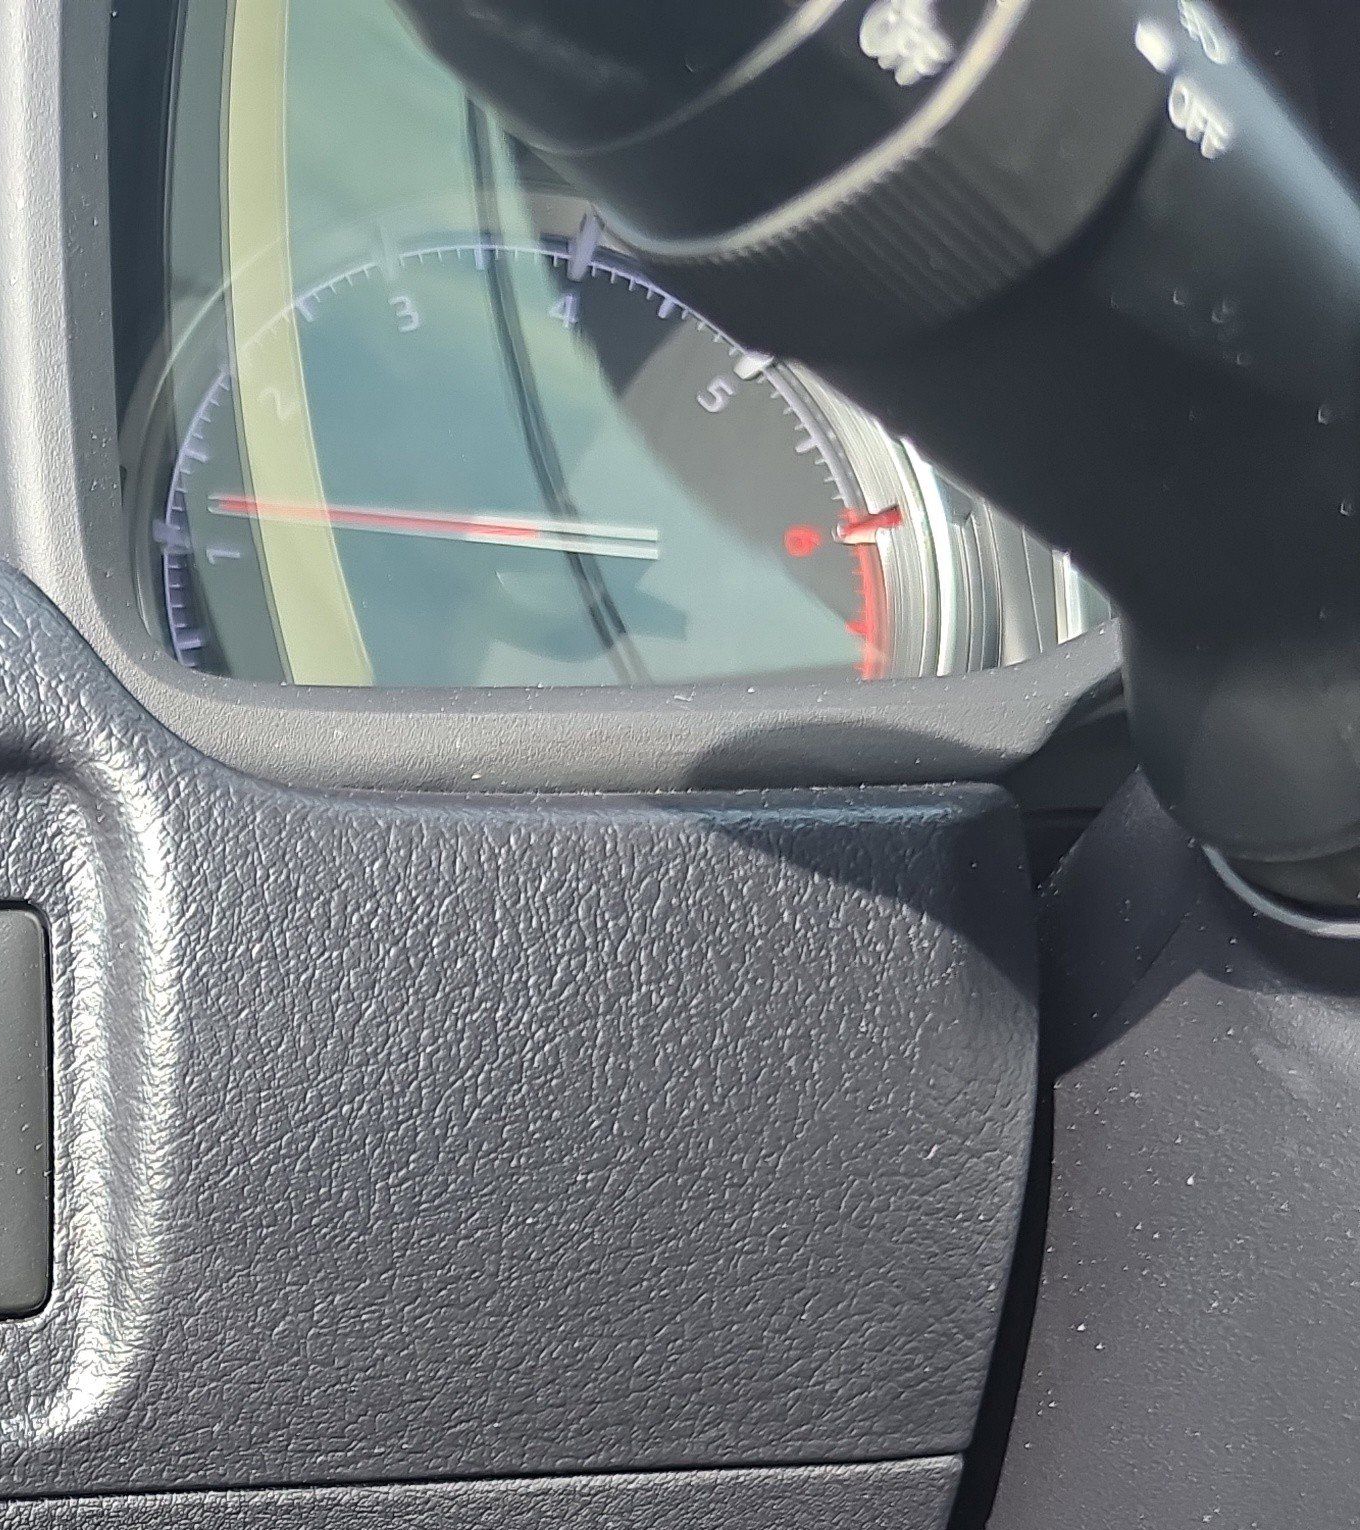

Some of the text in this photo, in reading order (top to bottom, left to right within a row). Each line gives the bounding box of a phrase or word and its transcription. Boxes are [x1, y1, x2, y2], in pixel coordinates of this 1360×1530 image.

[388, 295, 422, 334] 3
[548, 292, 579, 329] 4
[696, 374, 736, 413] 5
